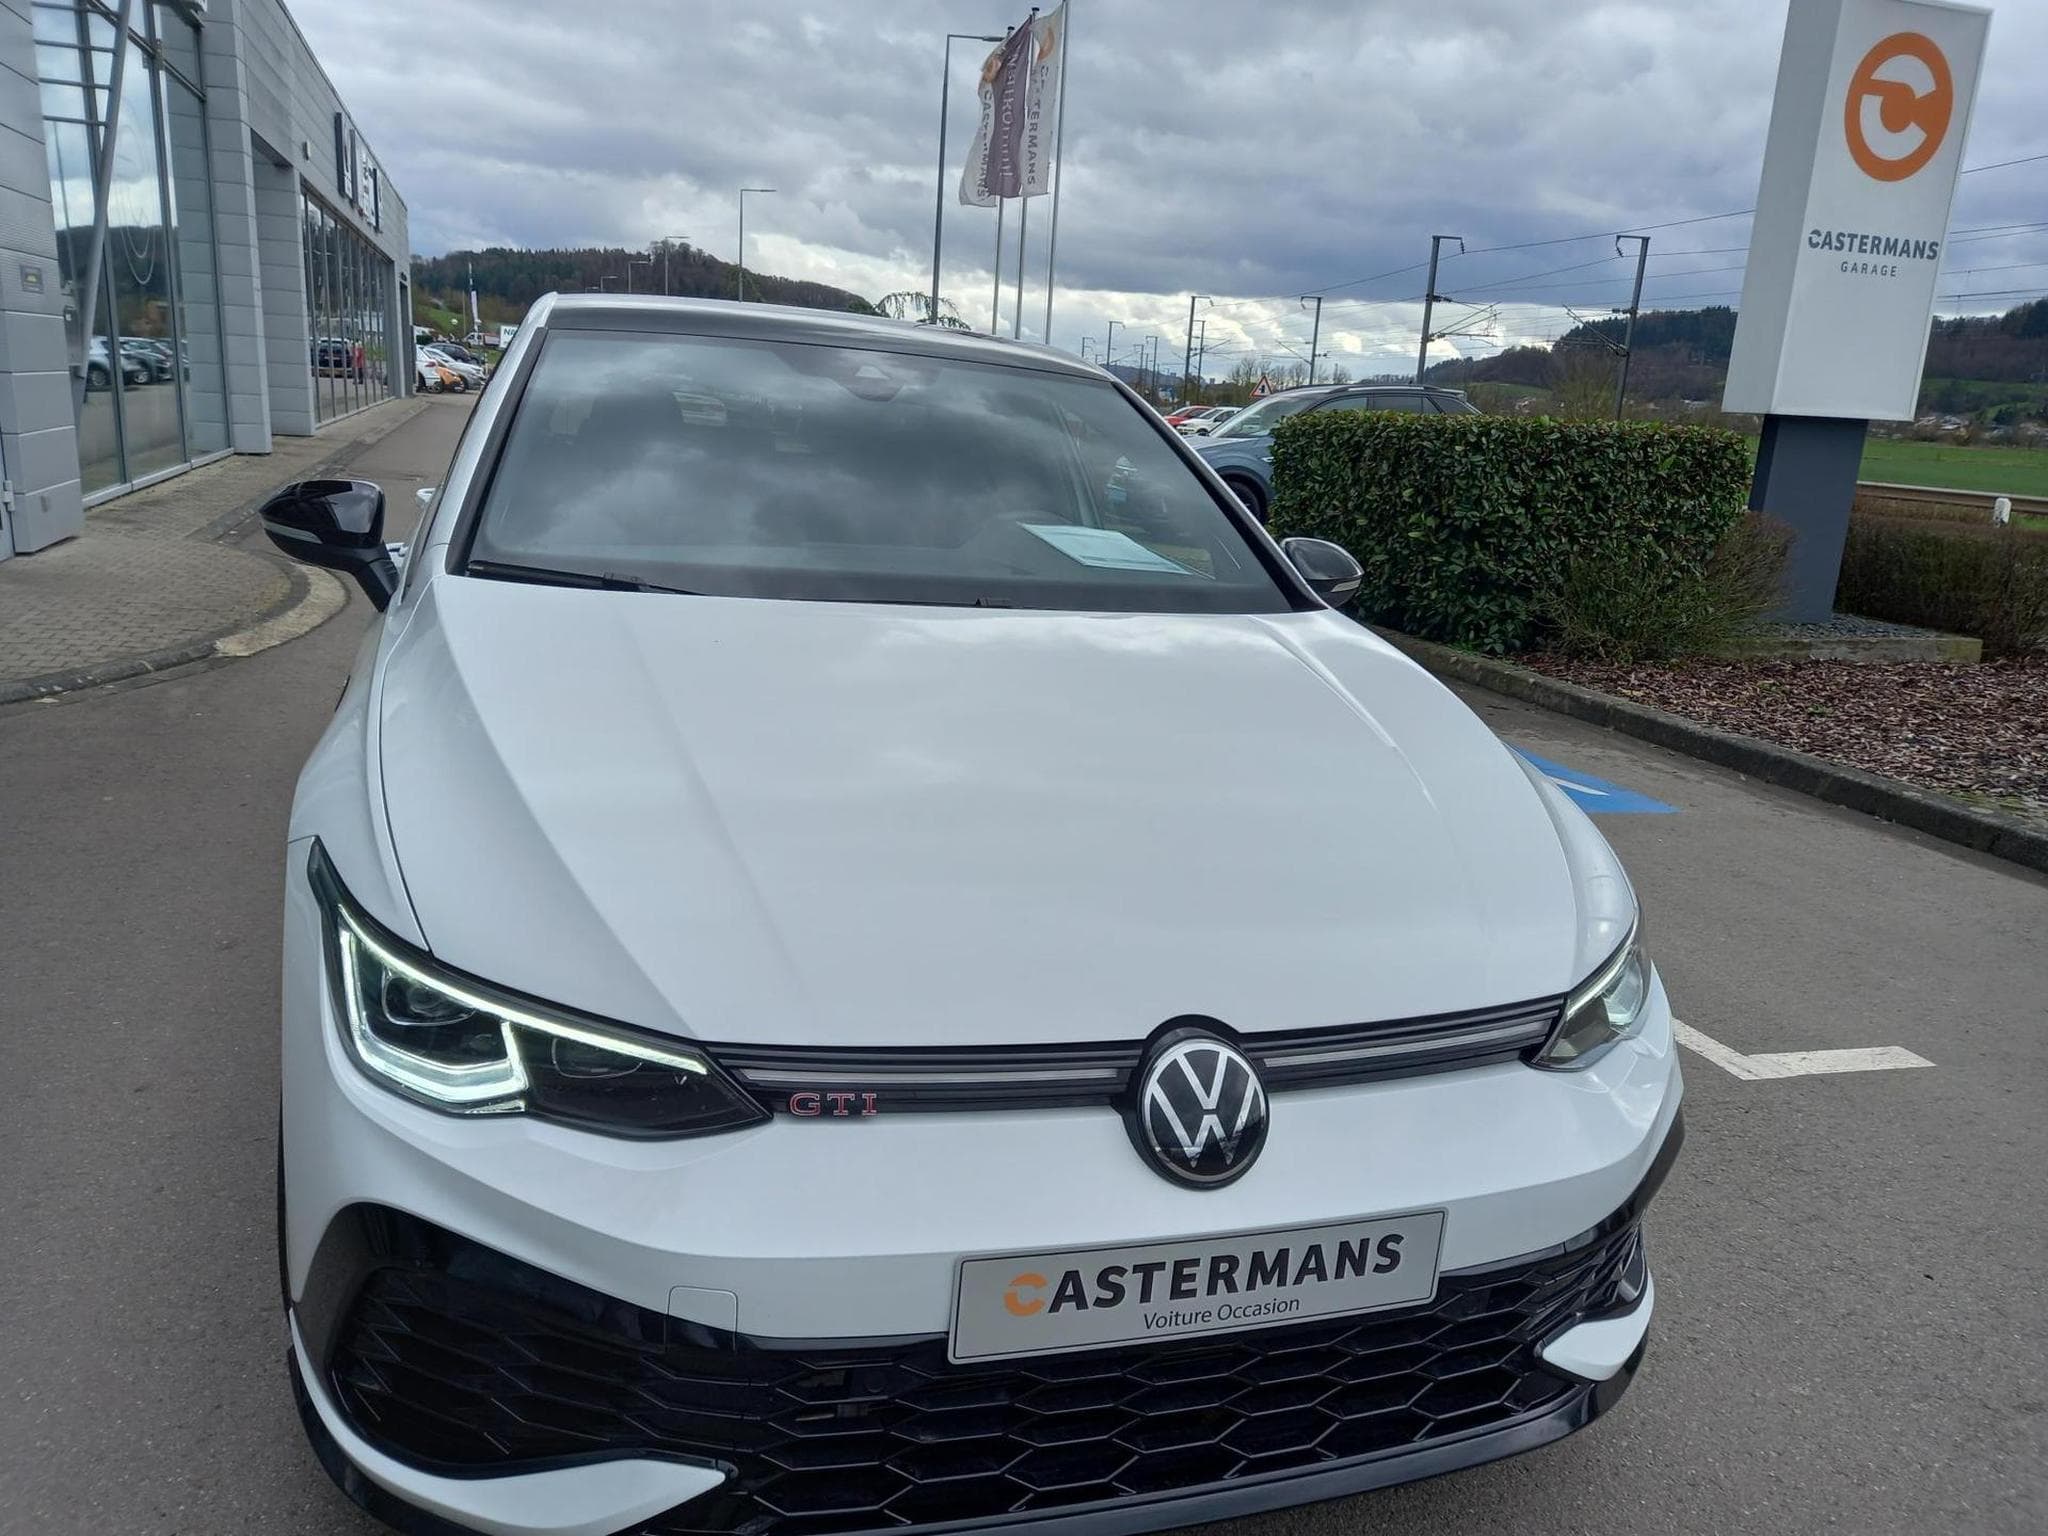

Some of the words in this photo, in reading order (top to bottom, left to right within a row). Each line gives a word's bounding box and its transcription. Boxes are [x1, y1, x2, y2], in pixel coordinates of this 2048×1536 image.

[1808, 229, 1939, 260] CASTERMANS
[1841, 261, 1897, 277] GARAGE
[789, 1091, 878, 1116] GTI
[1004, 1233, 1404, 1318] CASTERMANS
[1143, 1310, 1212, 1331] Voiture
[1217, 1297, 1300, 1322] Occasion
